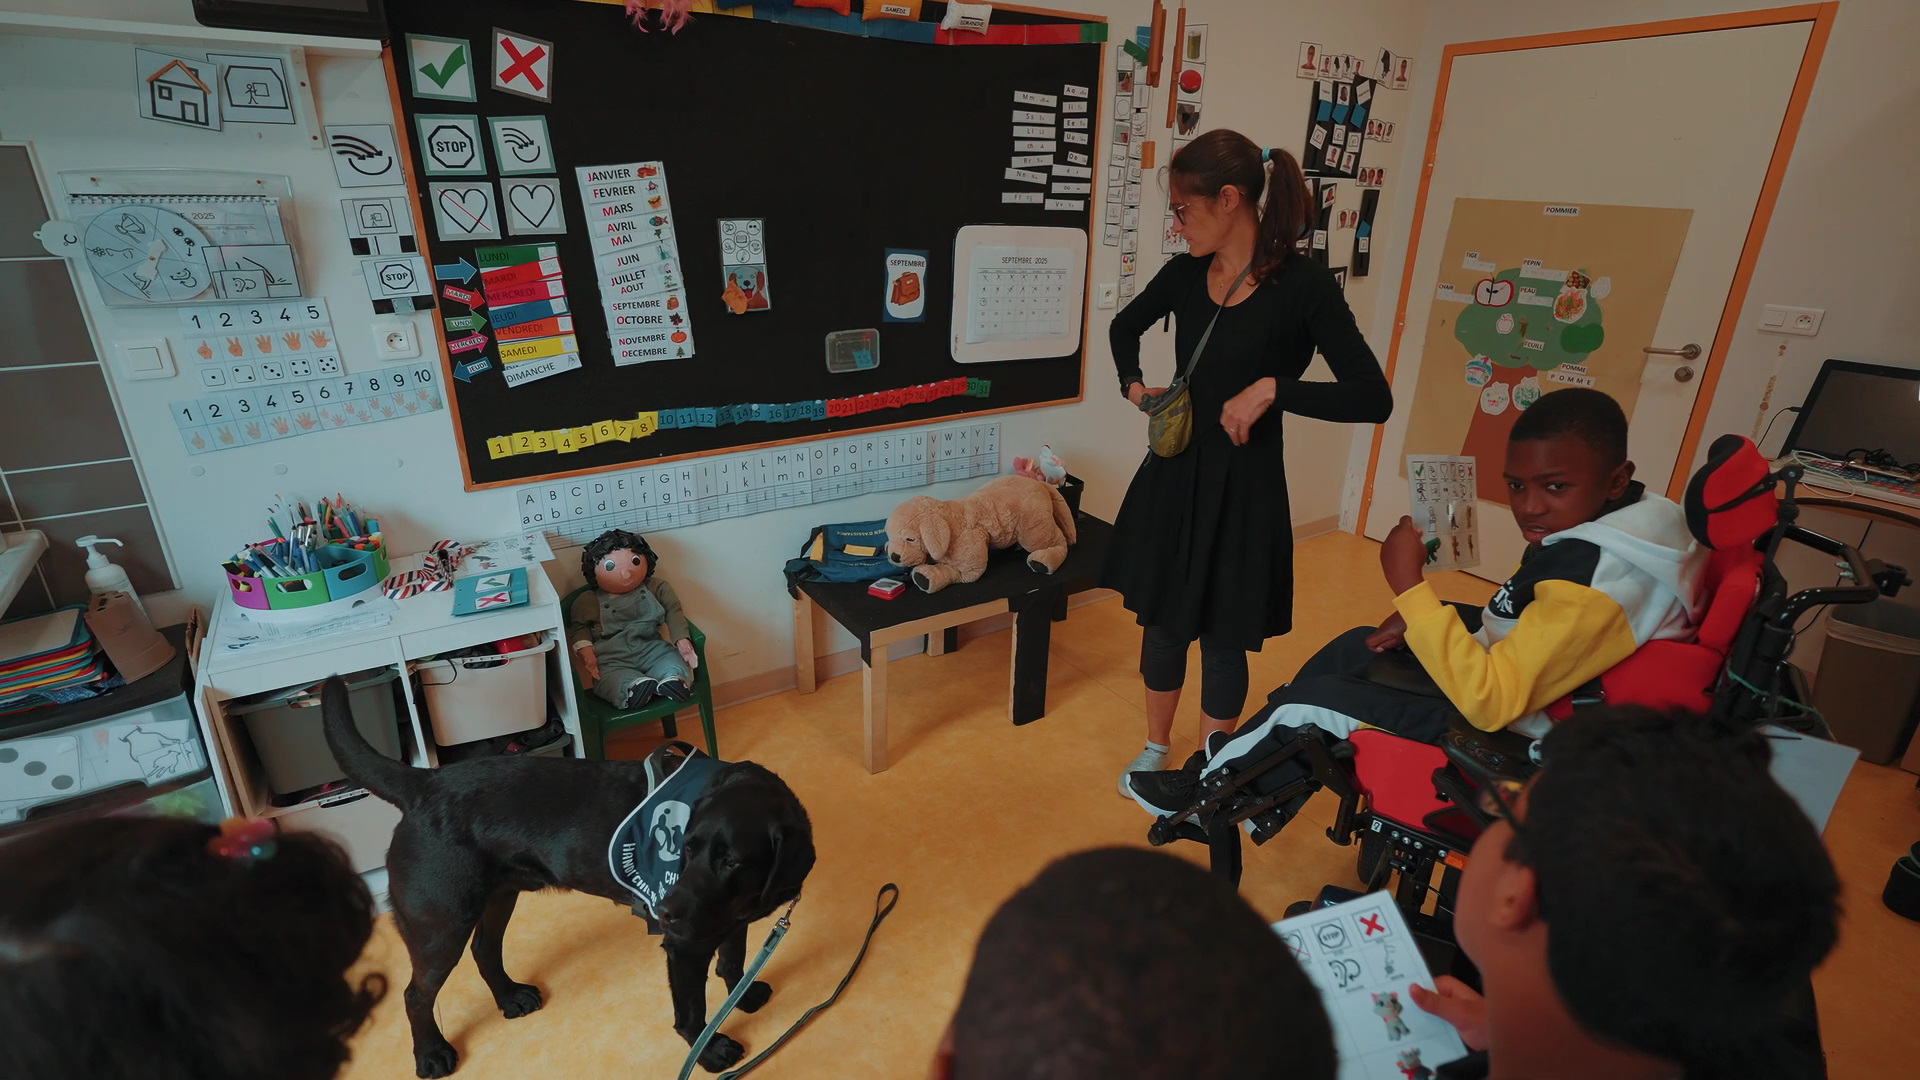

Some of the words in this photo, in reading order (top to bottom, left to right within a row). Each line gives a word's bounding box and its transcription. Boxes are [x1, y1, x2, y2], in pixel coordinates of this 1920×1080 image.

[885, 6, 906, 14] SAMEDI
[436, 140, 467, 153] STOP
[587, 168, 631, 182] JANVIER
[593, 185, 636, 199] FEVRIER
[192, 212, 215, 221] 2025
[602, 204, 634, 217] MARS
[1546, 207, 1578, 215] POMMIER
[607, 221, 637, 233] AVRIL
[611, 234, 633, 247] MAI
[479, 253, 510, 262] LUNDI
[617, 254, 640, 267] JUIN
[890, 259, 925, 268] SEPTEMBRE
[1002, 256, 1032, 264] SEPTEMBRE
[1035, 257, 1048, 265] 2025
[386, 272, 408, 281] STOP
[485, 273, 517, 285] MARDI
[610, 270, 647, 287] JUILLET
[620, 282, 644, 294] AOUT
[446, 289, 471, 301] MARDI
[487, 288, 536, 301] MERCREDI
[612, 300, 660, 311] SEPTEMBRE
[191, 314, 201, 329] 1
[219, 312, 233, 327] 2
[250, 310, 263, 324] 3
[280, 308, 291, 322] 4
[307, 306, 320, 320] 5
[491, 312, 518, 324] JEUDI
[616, 315, 663, 325] OCTOBRE
[496, 324, 543, 335] VENDREDI
[450, 337, 484, 350] MERCREDI
[618, 333, 666, 346] NOVEMBRE
[500, 346, 537, 359] SAMEDI
[621, 347, 667, 358] DECEMBRE
[469, 362, 487, 373] JEUDI
[506, 363, 556, 383] DIMANCHE
[1562, 364, 1586, 373] POMME
[182, 408, 193, 421] 1
[208, 404, 222, 418] 2
[238, 399, 251, 412] 3
[267, 395, 277, 408] 4
[292, 390, 304, 404] 5
[320, 386, 330, 399] 6
[344, 382, 354, 395] 7
[369, 379, 380, 391] 8
[393, 373, 405, 387] 9
[414, 369, 432, 383] 10
[495, 443, 504, 454] 1
[522, 437, 529, 447] 2
[539, 438, 546, 448] 3
[563, 438, 571, 448] 4
[580, 433, 587, 444] 5
[601, 425, 608, 436] 6
[618, 426, 626, 436] 7
[640, 423, 648, 433] 8
[660, 414, 674, 425] 10
[679, 413, 694, 424] 11
[700, 414, 713, 423] 12
[719, 410, 732, 421] 13
[736, 409, 748, 420] 14
[769, 409, 782, 418] 16
[785, 408, 796, 418] 17
[799, 405, 811, 414] 18
[813, 407, 825, 417] 19
[829, 403, 840, 413] 20
[842, 403, 853, 413] 21
[859, 400, 870, 410] 22
[874, 396, 885, 406] 23
[889, 396, 901, 405] 24
[903, 390, 914, 401] 25
[929, 388, 938, 398] 27
[941, 385, 951, 394] 28
[956, 381, 965, 390] 29
[979, 385, 988, 394] 31
[525, 495, 535, 504] A
[550, 491, 557, 500] B
[571, 487, 581, 497] C
[595, 484, 603, 493] D
[618, 480, 624, 489] E
[640, 477, 646, 486] F
[660, 473, 670, 483] G
[682, 472, 690, 480] H
[723, 465, 728, 474] J
[742, 462, 748, 470] K
[761, 459, 766, 467] L
[778, 456, 786, 464] M
[797, 454, 803, 462] N
[815, 450, 822, 459] O
[849, 445, 857, 454] Q
[867, 443, 872, 451] R
[884, 441, 889, 449] S
[900, 439, 905, 447] T
[916, 437, 922, 446] U
[961, 432, 966, 440] X
[990, 428, 994, 436] Z
[523, 515, 530, 524] a
[534, 512, 543, 521] a
[552, 508, 560, 518] b
[575, 507, 583, 515] c
[598, 501, 606, 511] d
[620, 499, 627, 508] e
[642, 493, 647, 503] f
[663, 493, 671, 503] g
[684, 488, 691, 497] h
[744, 479, 749, 487] k
[778, 473, 788, 481] m
[816, 468, 822, 476] o
[834, 465, 840, 475] p
[850, 462, 857, 472] q
[884, 457, 889, 465] s
[916, 453, 922, 461] u
[931, 451, 936, 459] v
[975, 446, 979, 455] y
